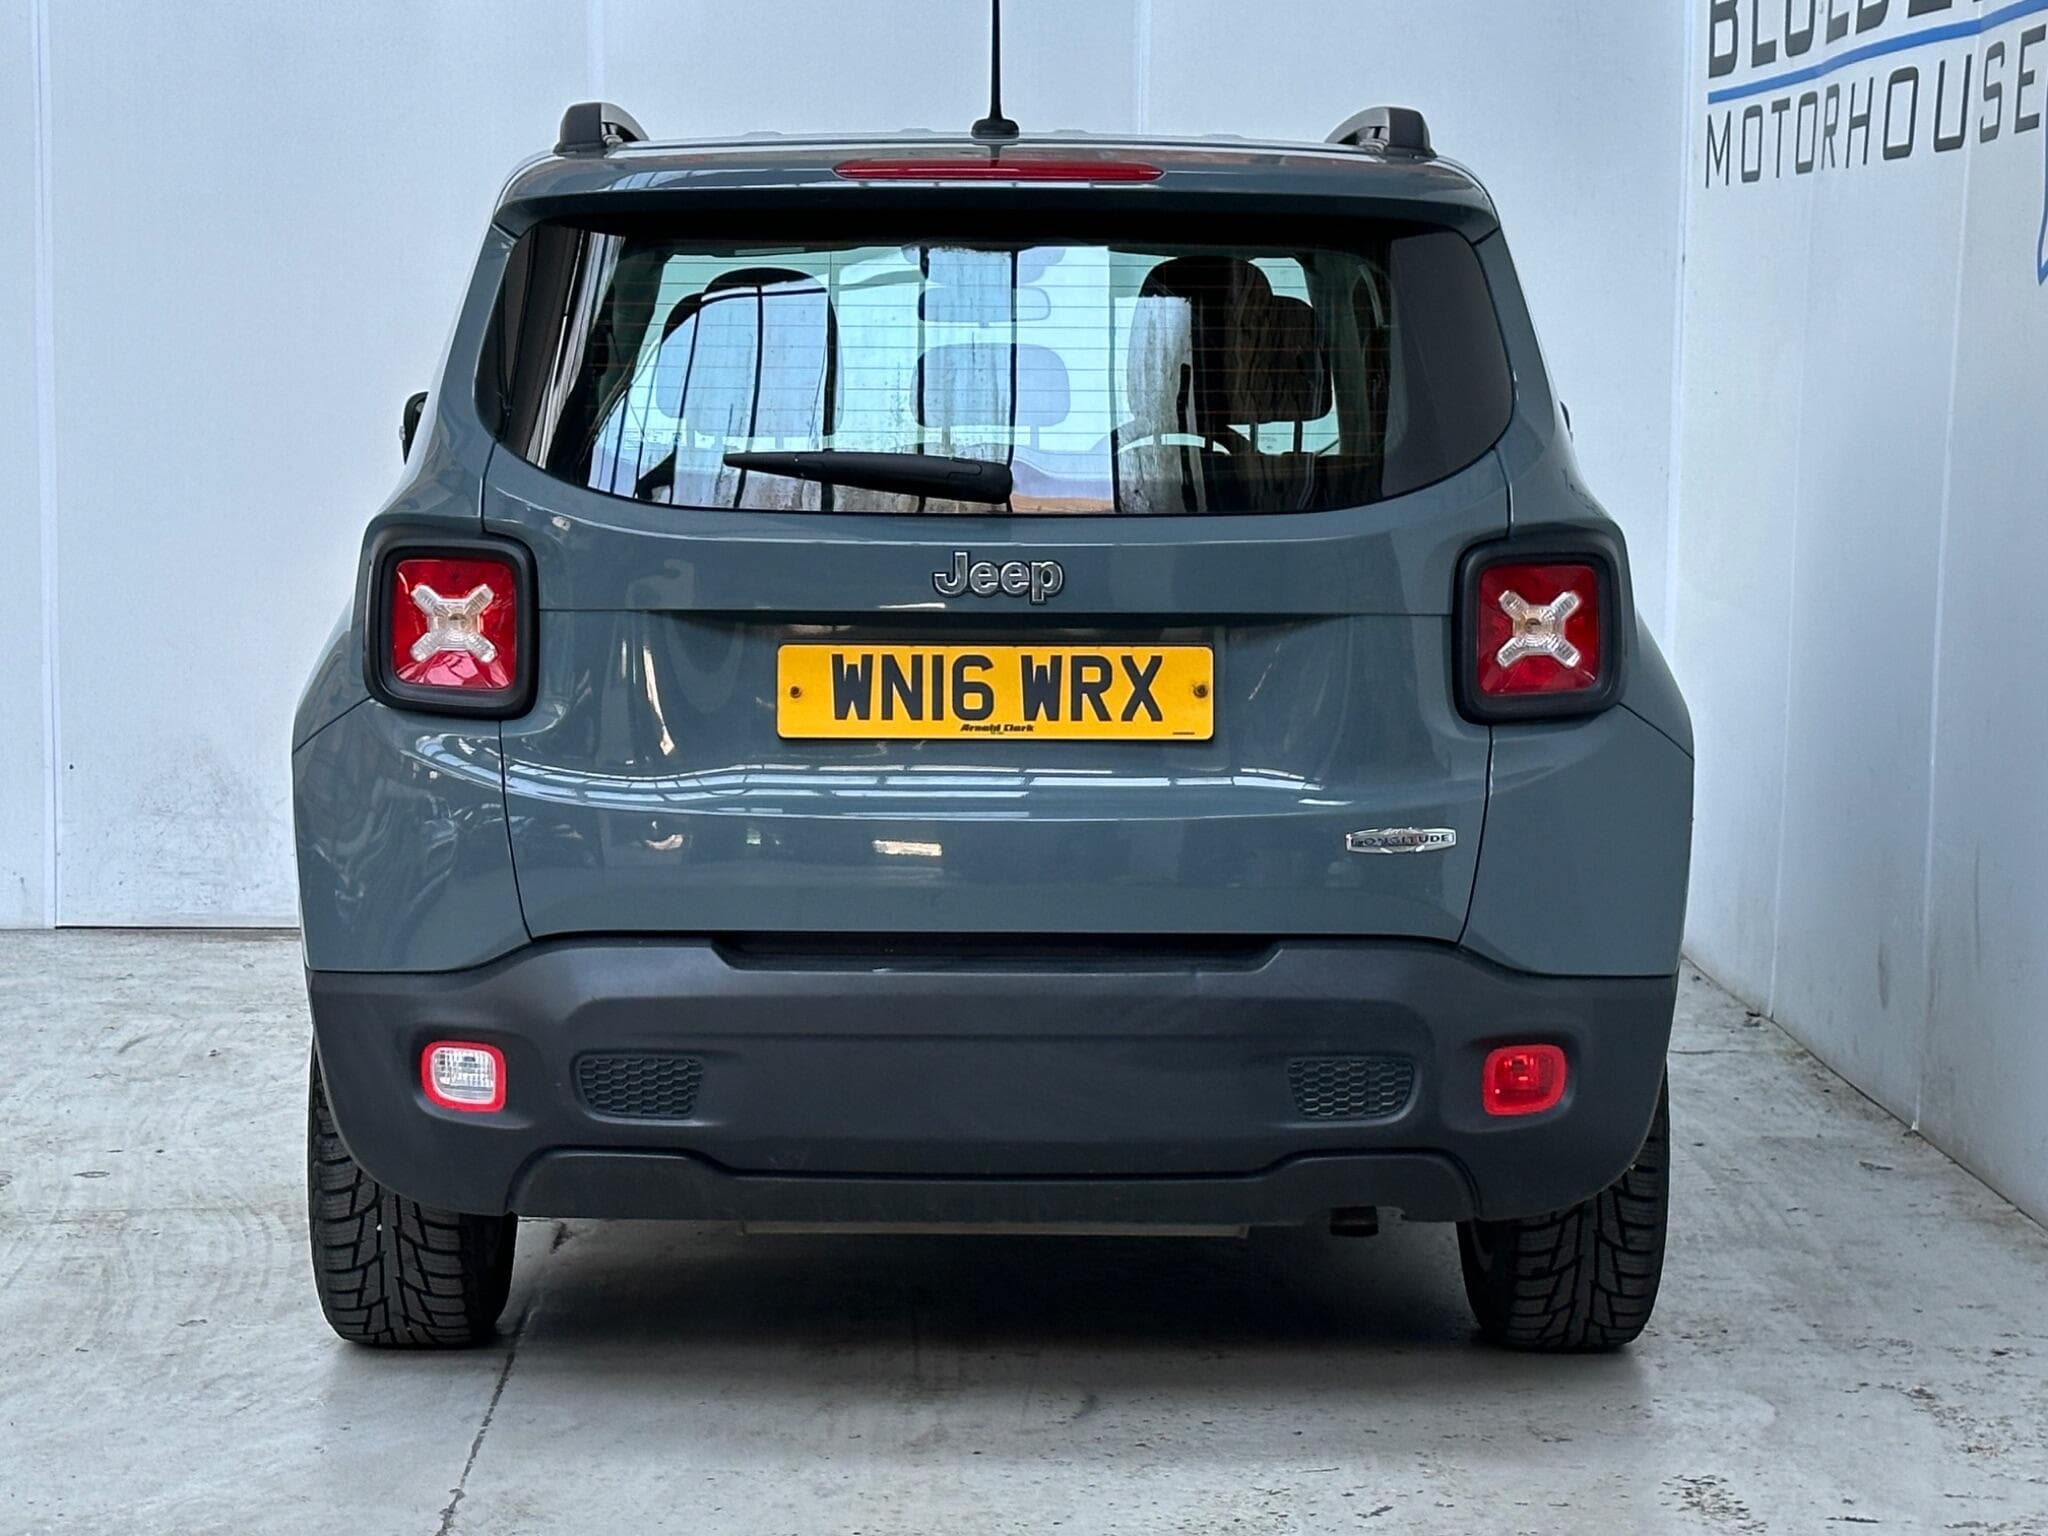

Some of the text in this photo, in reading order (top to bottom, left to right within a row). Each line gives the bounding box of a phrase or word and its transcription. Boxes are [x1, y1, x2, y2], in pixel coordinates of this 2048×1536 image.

[1705, 24, 2047, 189] MOTORHOUSE
[934, 551, 1063, 602] Jeep
[831, 653, 1163, 722] WN16 WRX
[960, 723, 1034, 732] Arnold Clark
